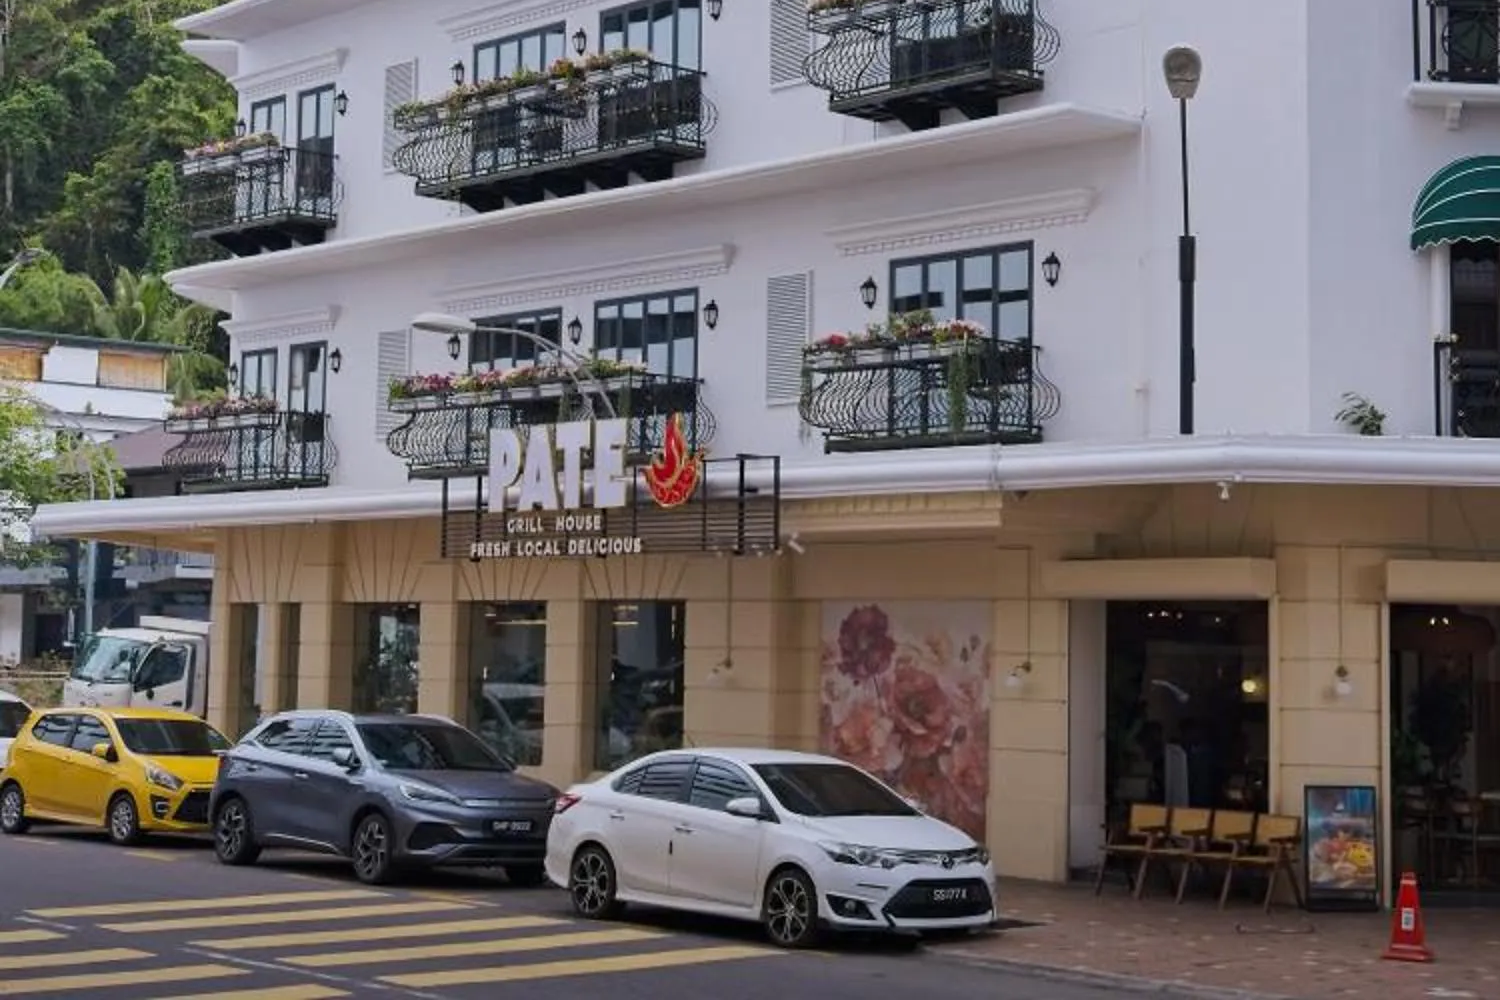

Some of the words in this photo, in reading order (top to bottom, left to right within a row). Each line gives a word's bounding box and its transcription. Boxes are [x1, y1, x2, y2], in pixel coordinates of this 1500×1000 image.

[488, 418, 627, 512] PATE
[507, 514, 544, 533] GRILL
[555, 513, 601, 531] HOUSE
[469, 541, 510, 557] FRESH
[517, 539, 560, 556] LOCAL
[568, 537, 641, 554] DELICIOUS
